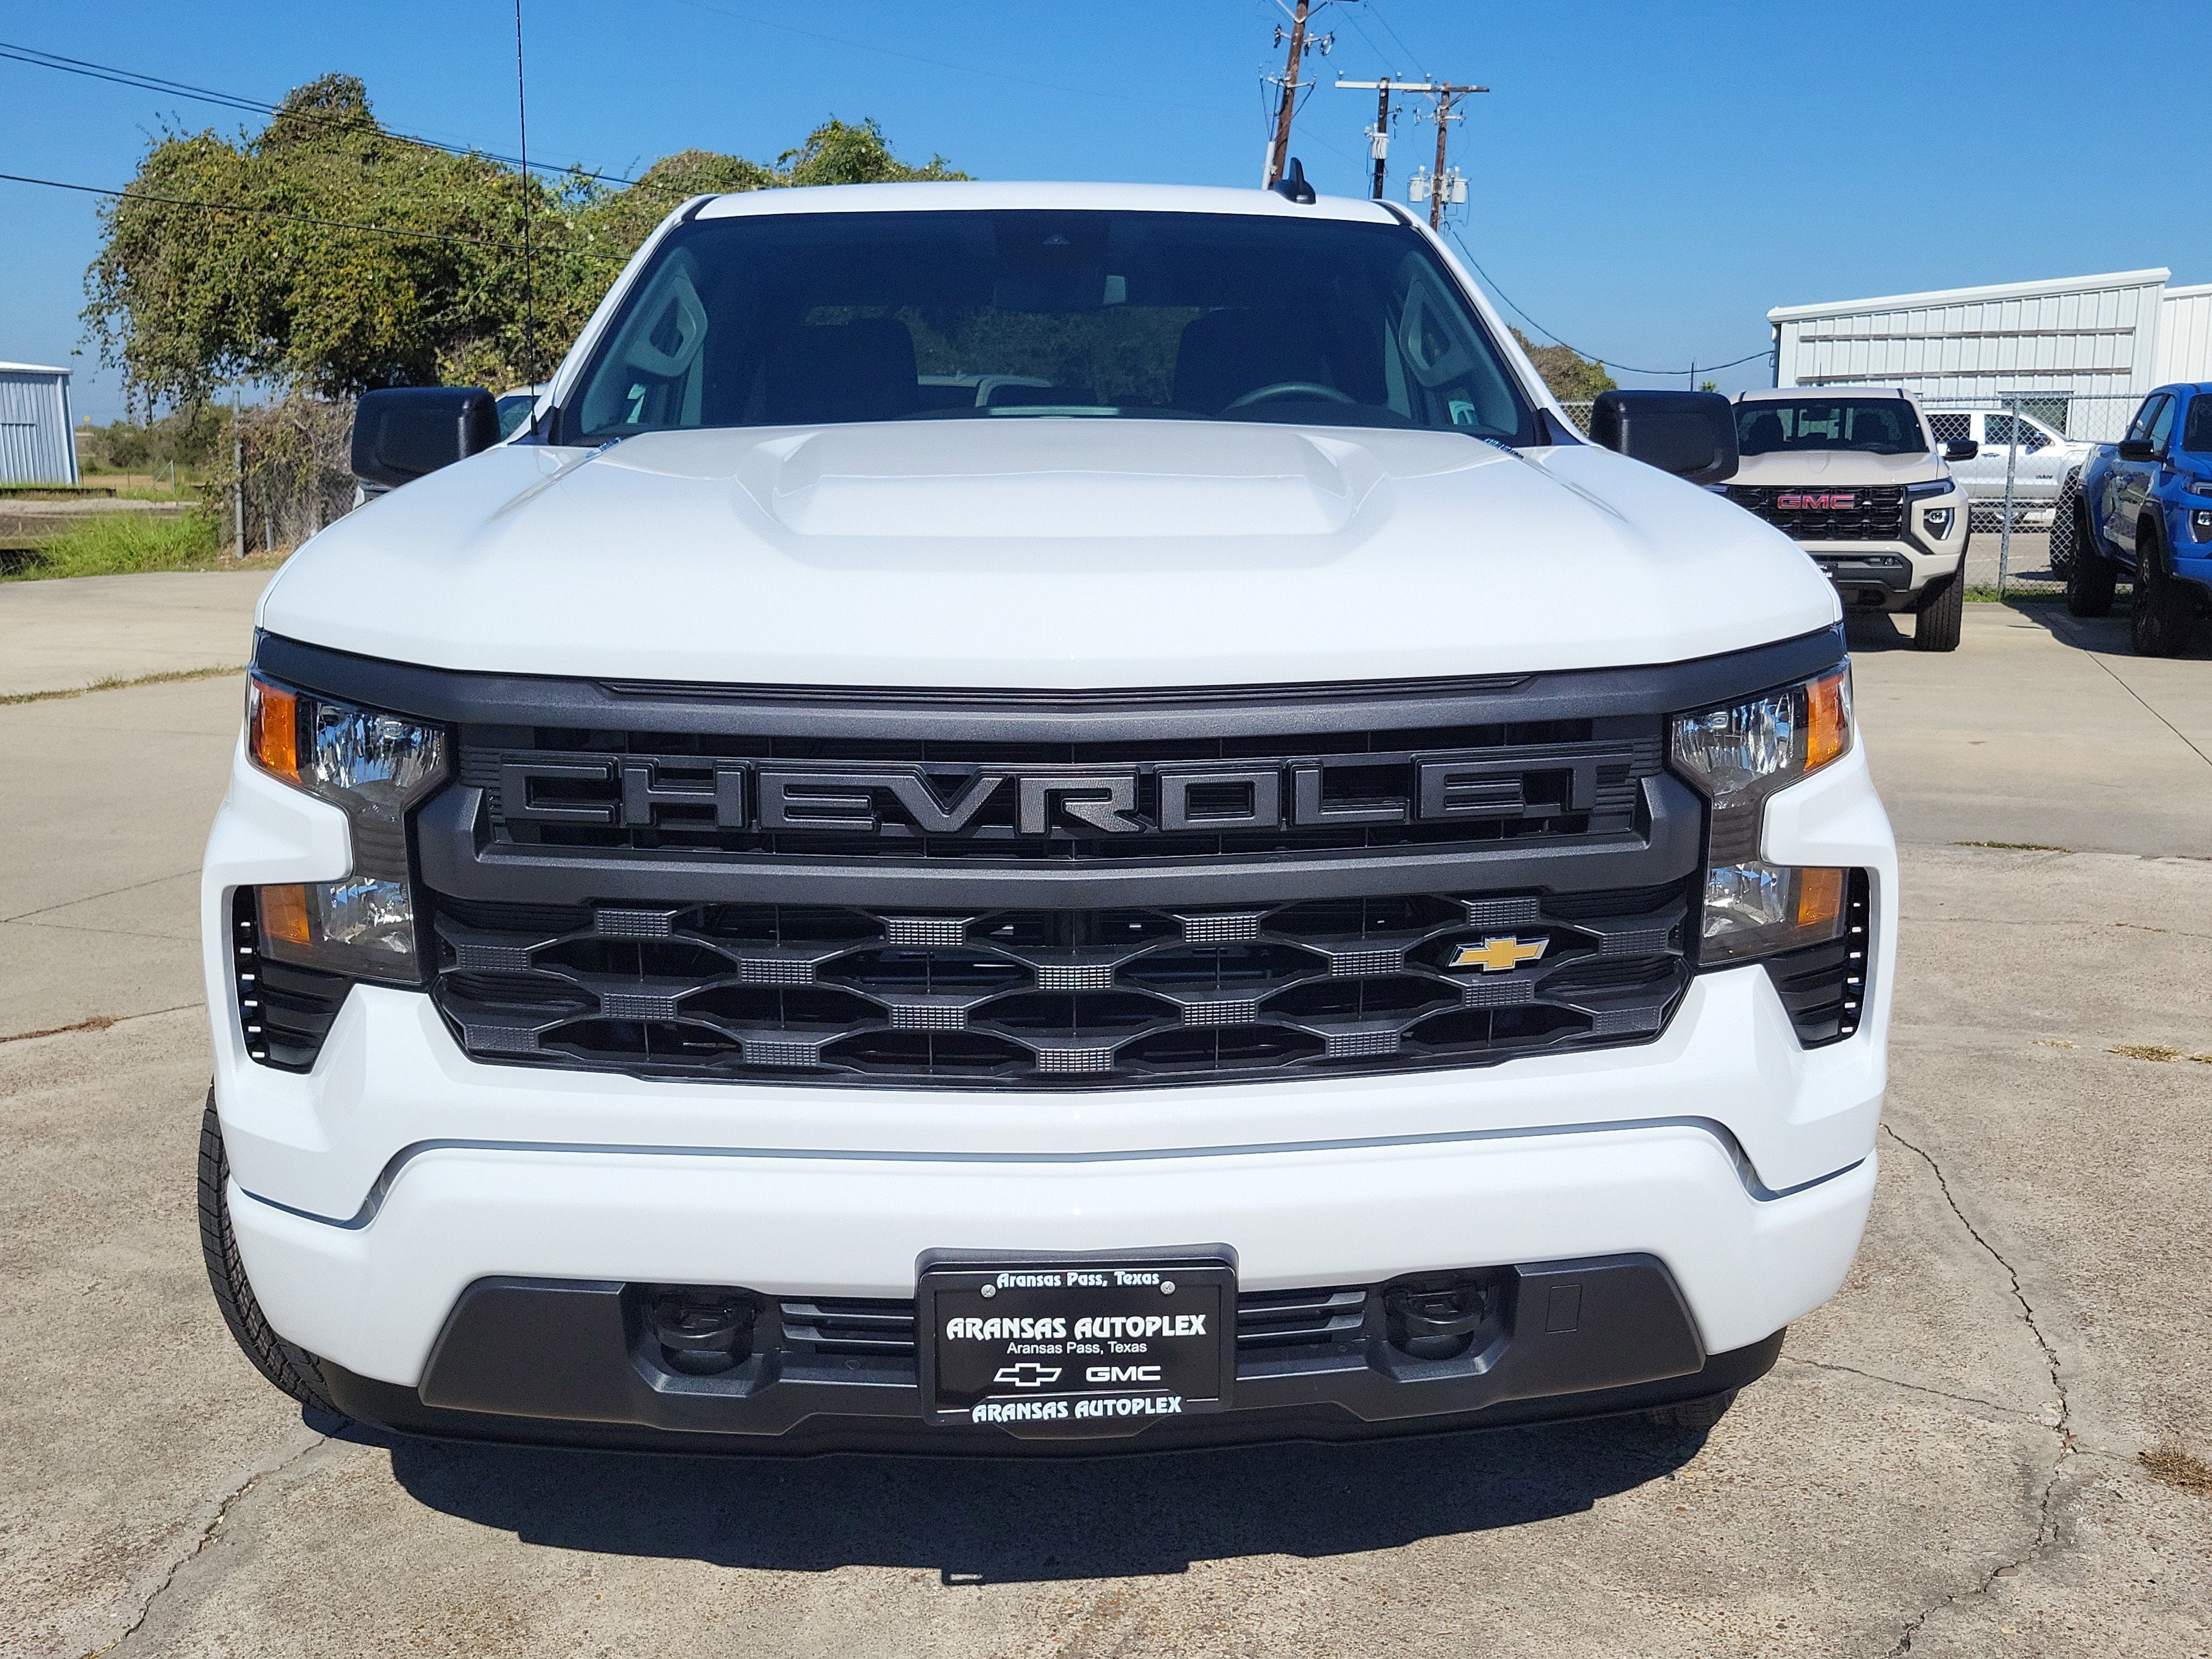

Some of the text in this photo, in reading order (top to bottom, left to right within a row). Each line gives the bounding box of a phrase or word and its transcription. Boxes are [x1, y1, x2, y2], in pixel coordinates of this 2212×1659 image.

[1777, 494, 1854, 509] GMC
[500, 753, 1632, 834] CHEVROLET
[997, 1271, 1160, 1289] Aransas Pass, Texas
[946, 1314, 1207, 1340] ARANSAS AUTOPLEX
[1006, 1340, 1147, 1355] Aransas Pass, Texas
[1086, 1365, 1161, 1382] GMC
[972, 1396, 1182, 1423] ARANSAS AUTOPLEX
